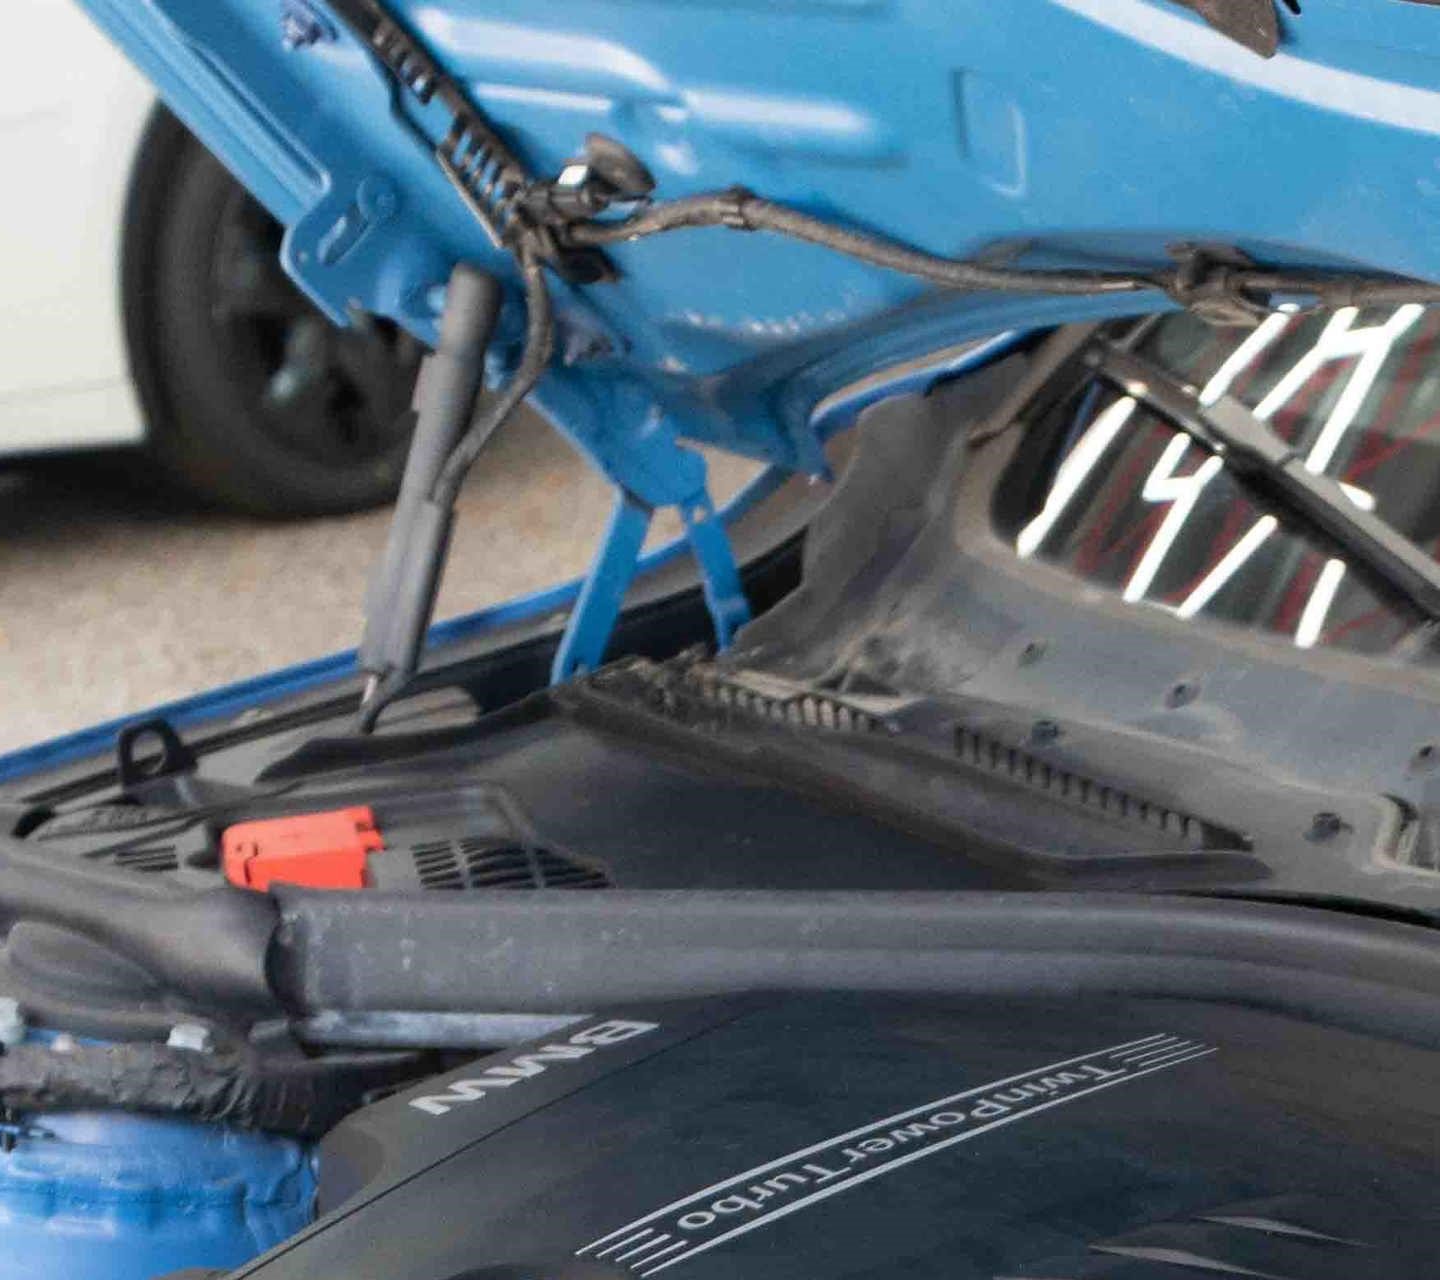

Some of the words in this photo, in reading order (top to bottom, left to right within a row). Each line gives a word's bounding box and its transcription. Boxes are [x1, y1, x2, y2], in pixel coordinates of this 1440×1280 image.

[409, 1019, 659, 1115] BMW
[844, 1064, 1127, 1163] TwinPower
[676, 1163, 852, 1230] Turbo
